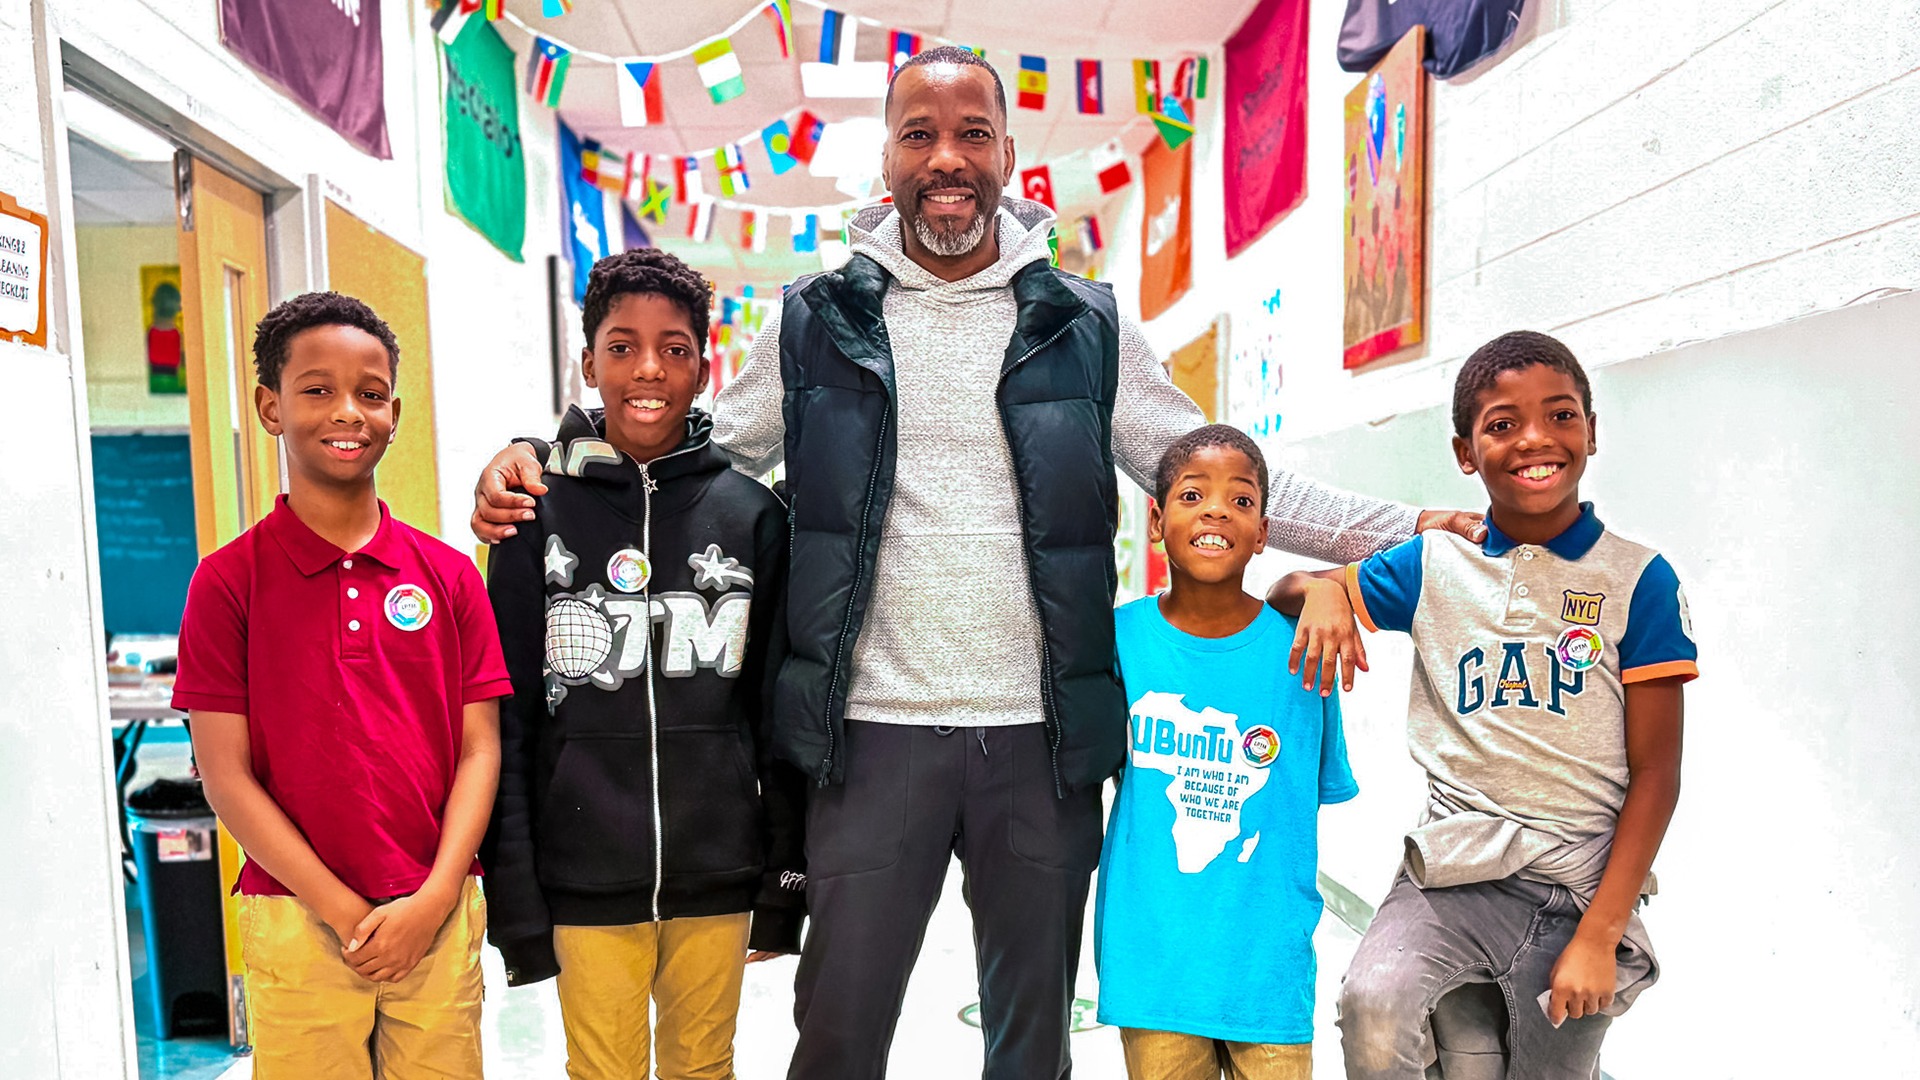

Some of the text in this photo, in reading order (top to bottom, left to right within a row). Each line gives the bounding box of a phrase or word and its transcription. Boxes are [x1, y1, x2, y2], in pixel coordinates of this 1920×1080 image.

[0, 281, 29, 300] ECKLIST
[1565, 598, 1598, 620] NYC
[1456, 640, 1585, 716] GAP
[1177, 765, 1249, 785] I AM WHO I AM
[1184, 780, 1239, 797] BECAUSE OF
[1180, 793, 1240, 810] WHO WE ARE
[1185, 806, 1231, 823] TOGETHER
